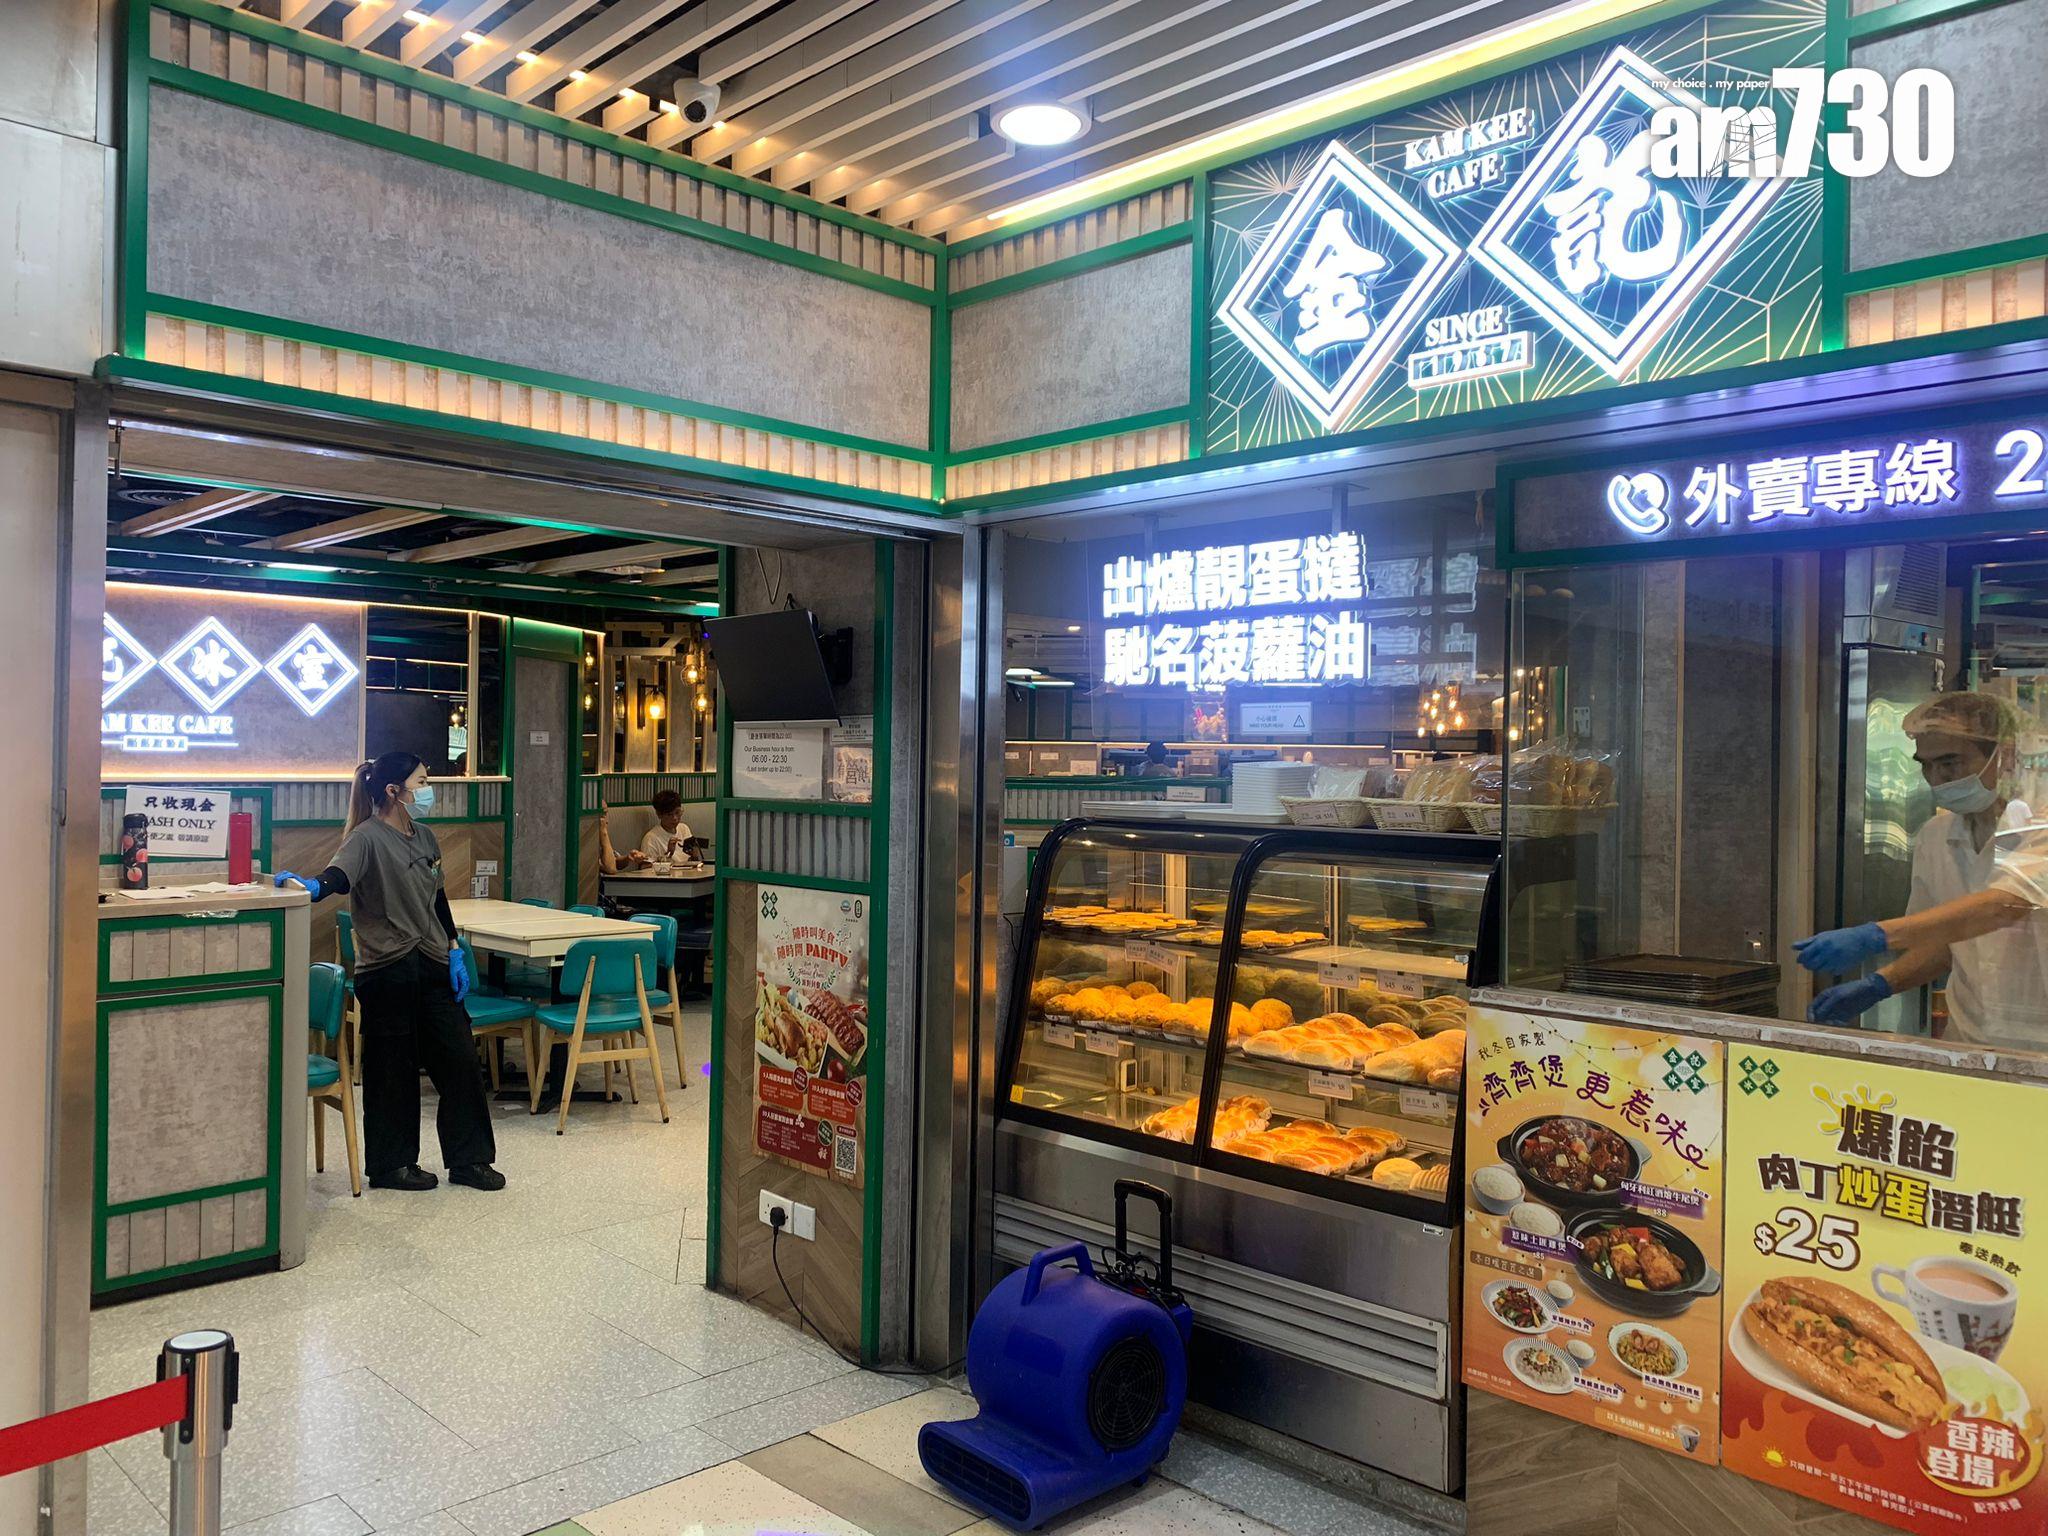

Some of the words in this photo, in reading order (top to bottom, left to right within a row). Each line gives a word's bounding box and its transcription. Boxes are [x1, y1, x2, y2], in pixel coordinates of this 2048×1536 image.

[1404, 127, 1465, 168] KAM
[1469, 106, 1530, 153] KEE
[1427, 154, 1504, 200] CAFE
[1425, 305, 1503, 347] SINCE
[1683, 439, 1958, 526] 外賣專線
[1104, 531, 1366, 618] 出爐靚蛋撻
[1104, 610, 1369, 687] 馳名菠蘿油
[101, 713, 127, 733] AM
[129, 714, 174, 734] KEE
[179, 715, 233, 735] CAFE
[144, 796, 216, 812] 只收現金
[146, 816, 174, 827] ASH
[178, 818, 216, 829] ONLY
[147, 832, 174, 841] 便之處
[806, 943, 849, 969] PARTY
[1478, 1032, 1546, 1061] 秋冬自家製
[1837, 1104, 1956, 1179] 爆餡
[1757, 1153, 2023, 1238] 肉丁炒蛋潛艇
[1754, 1206, 1861, 1272] $25
[1959, 1241, 2022, 1278] 奉送熱飲
[1947, 1420, 2016, 1461] 香辣
[1927, 1446, 1995, 1489] 登場
